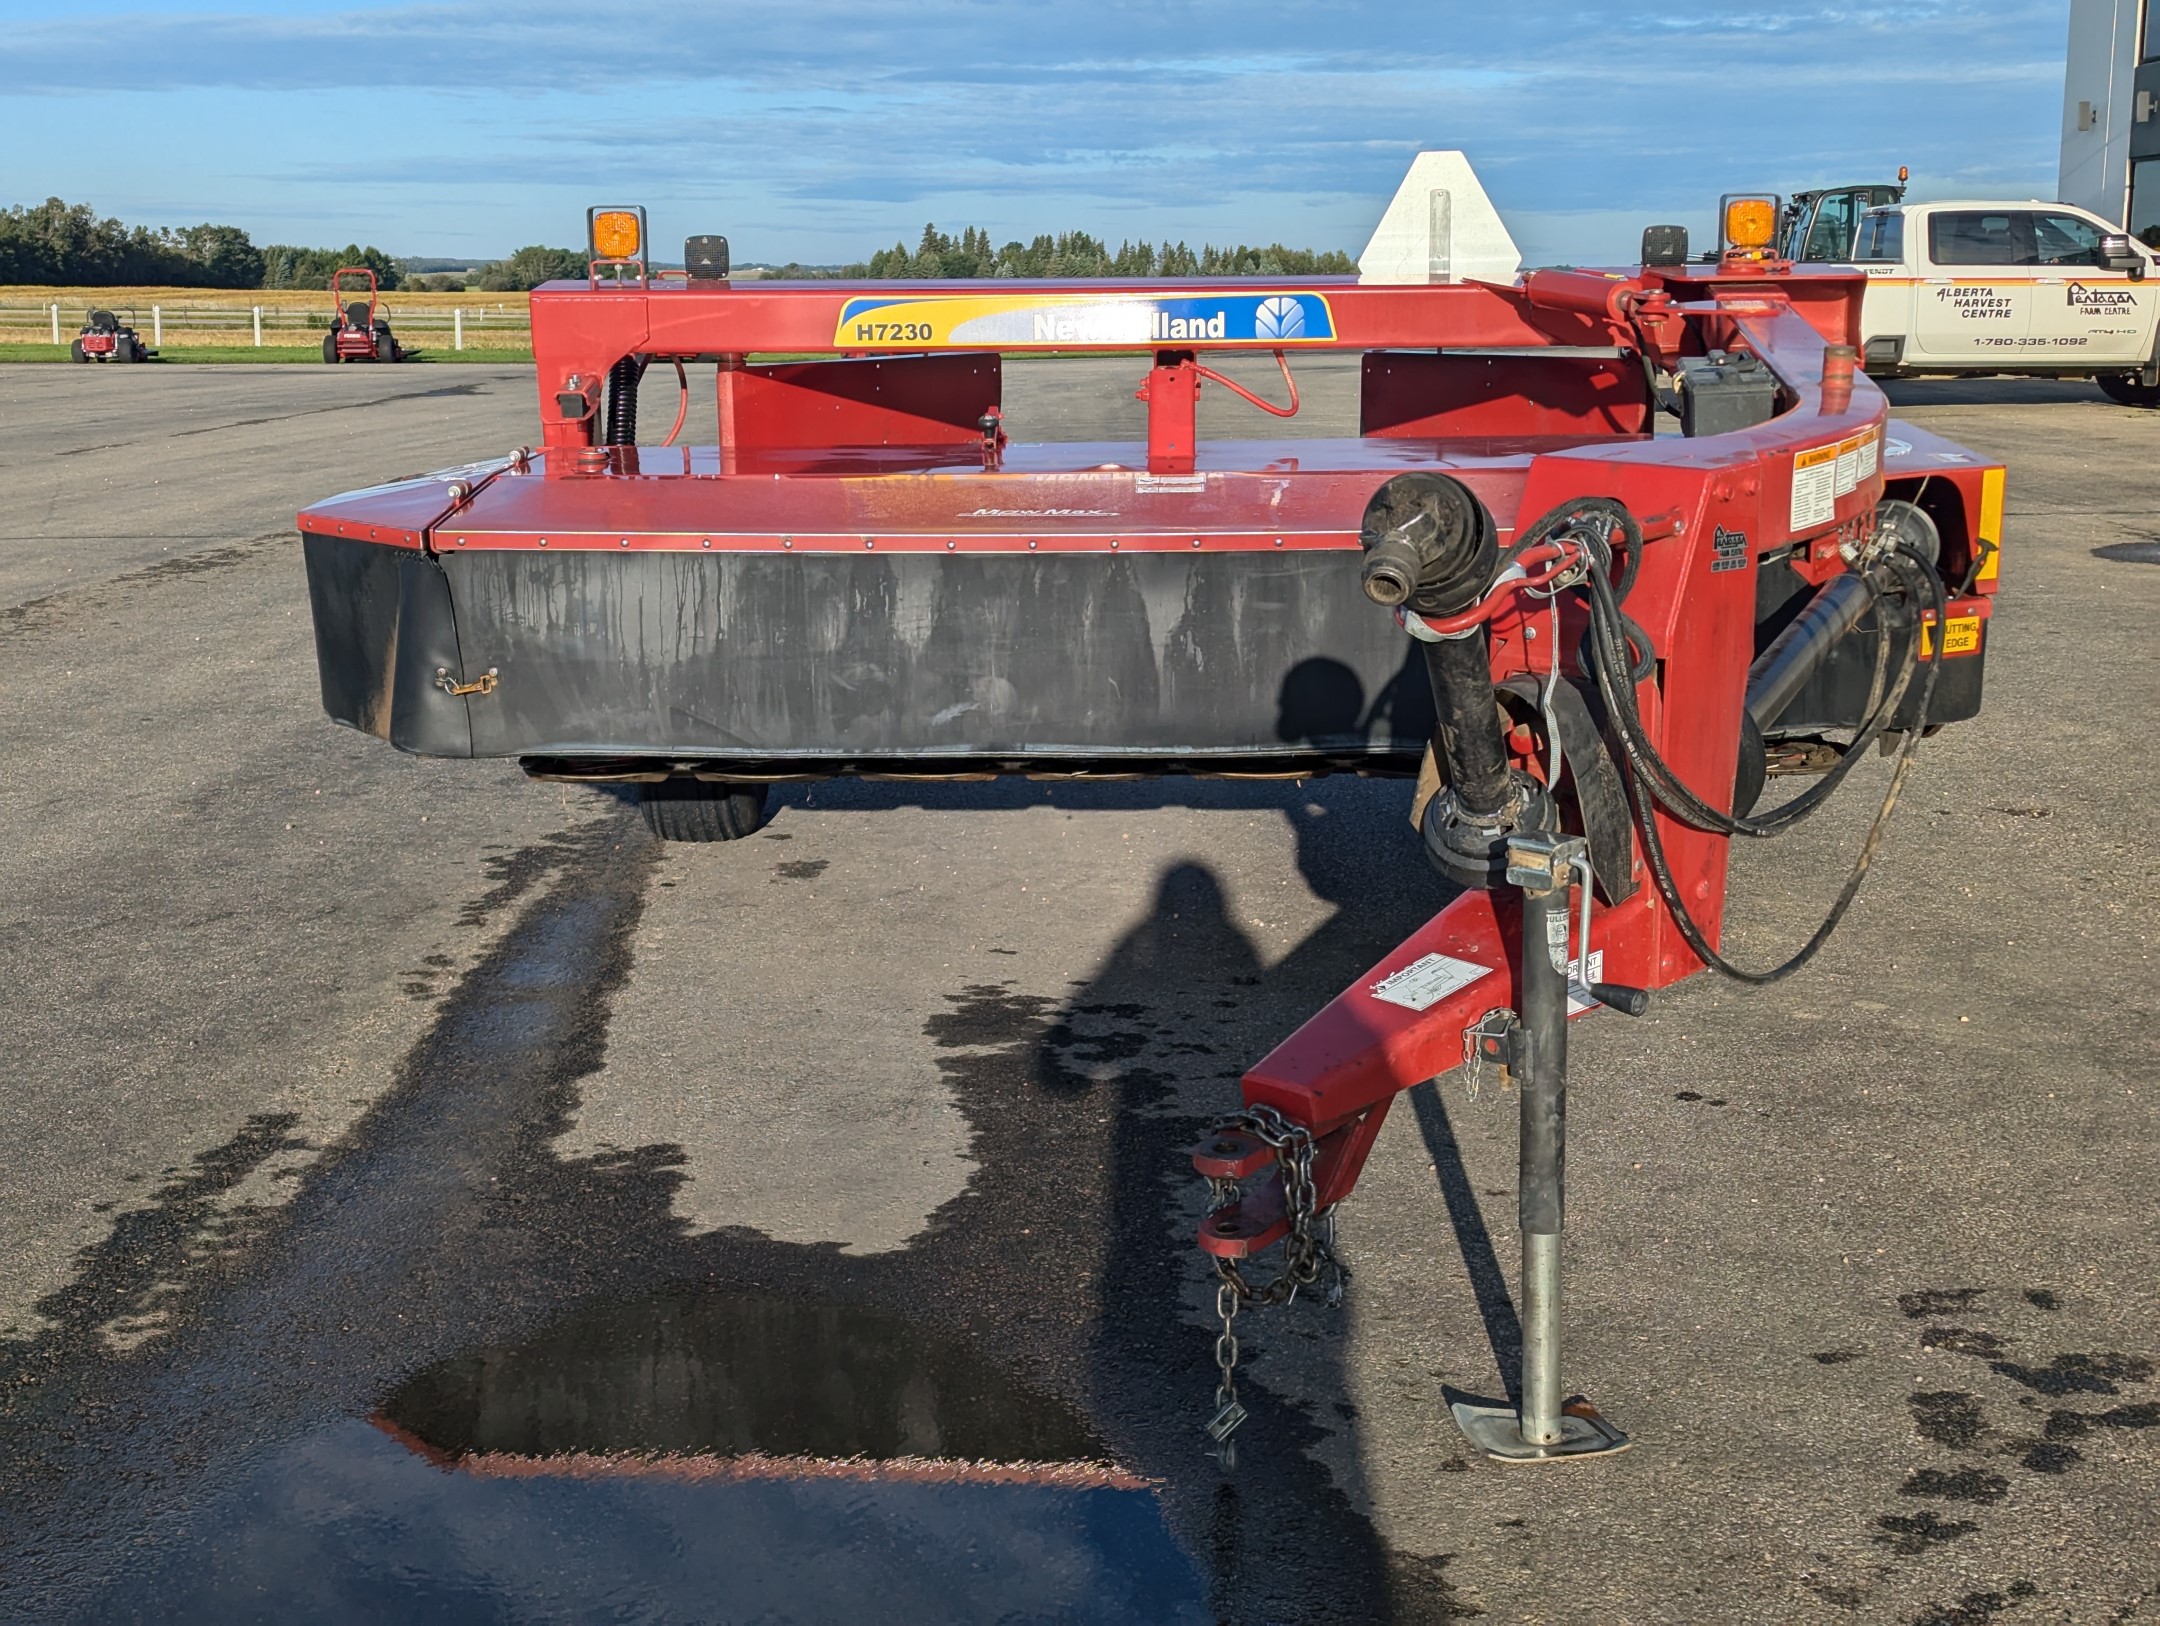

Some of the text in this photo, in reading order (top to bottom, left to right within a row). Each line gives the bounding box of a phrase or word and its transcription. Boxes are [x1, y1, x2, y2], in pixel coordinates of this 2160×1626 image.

[1936, 288, 1993, 302] ALBERTA
[1953, 299, 2011, 308] HARVEST
[1961, 309, 2011, 318] CENTRE
[2080, 307, 2101, 315] FARM
[857, 323, 932, 341] H7230
[1033, 312, 1094, 341] Ne
[1945, 621, 1977, 635] UTTING
[1946, 636, 1969, 649] EDGE
[1386, 957, 1436, 986] IMPORTANT
